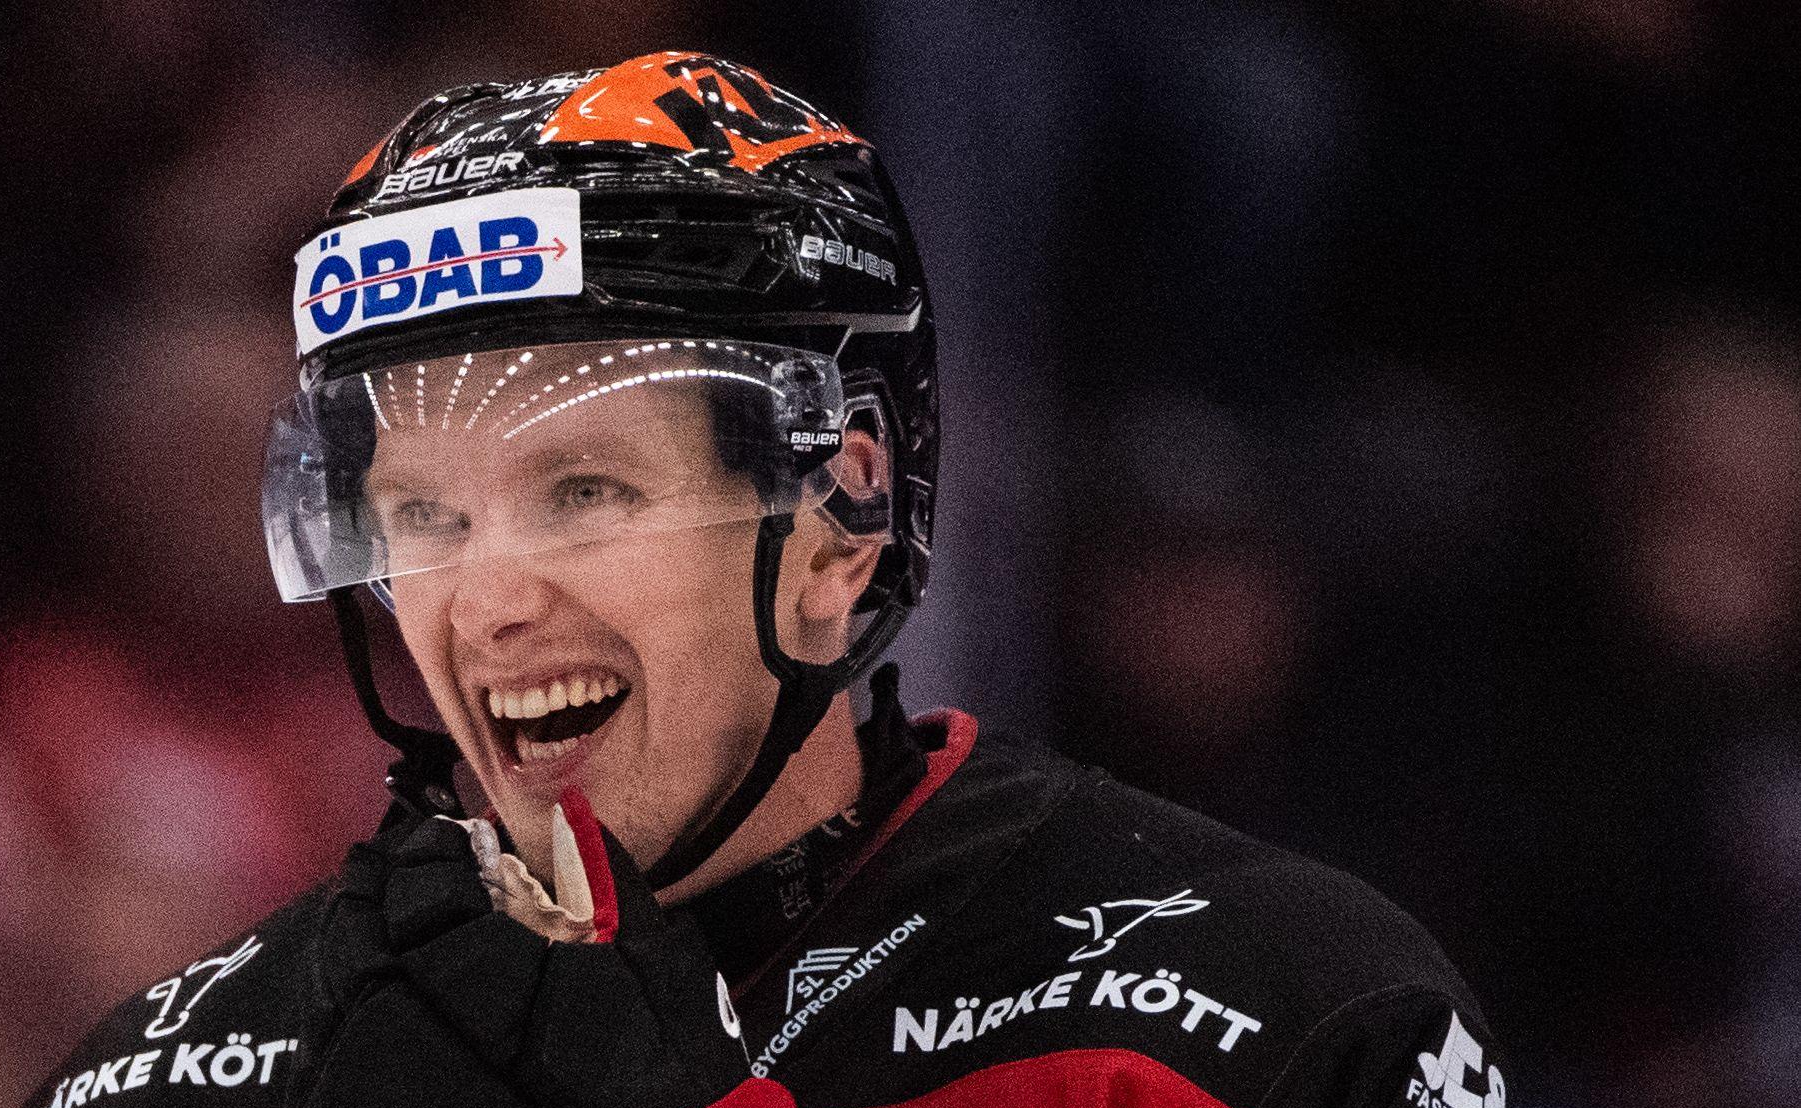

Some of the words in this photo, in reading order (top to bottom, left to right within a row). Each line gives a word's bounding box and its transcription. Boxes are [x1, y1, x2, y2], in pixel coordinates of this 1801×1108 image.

[377, 151, 525, 198] BAUER
[309, 216, 543, 335] ÖBAB
[800, 234, 896, 286] BAUER
[790, 431, 839, 446] BAUER
[751, 914, 927, 1078] BYGGPRODUKTION
[795, 974, 825, 999] SL
[893, 971, 1082, 1053] NÄRKE
[1089, 968, 1261, 1052] KÖTT
[169, 1033, 298, 1087] KÖT
